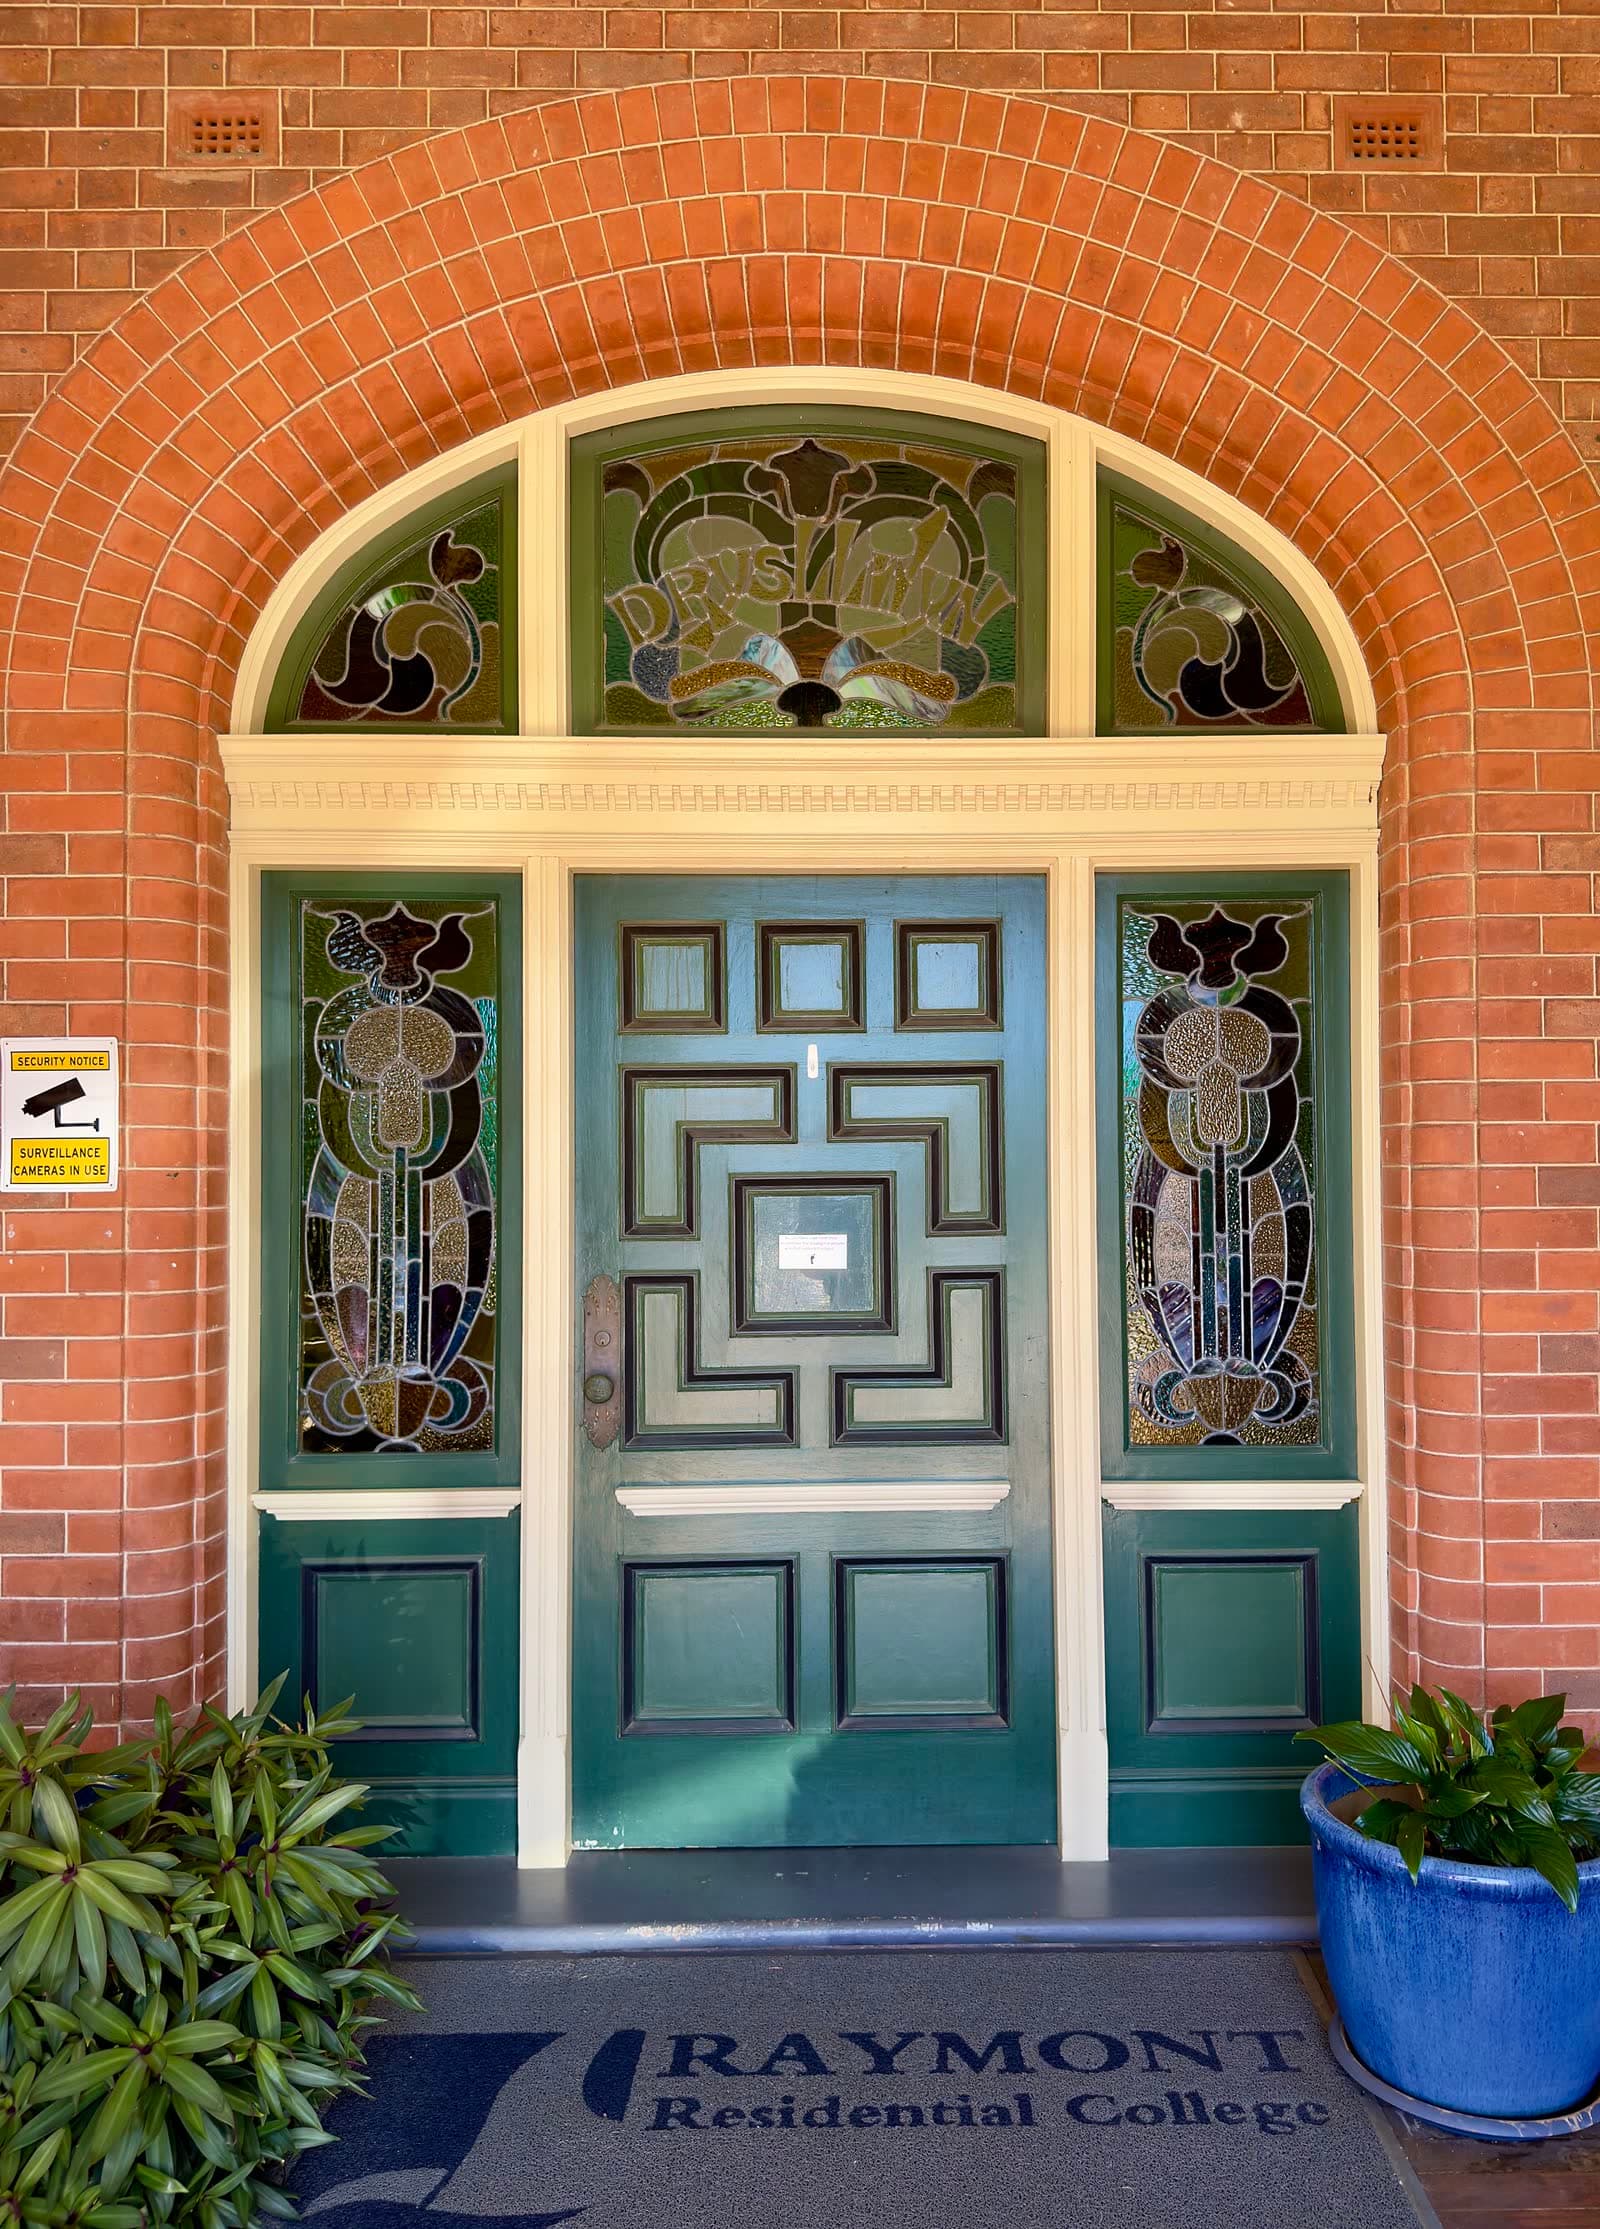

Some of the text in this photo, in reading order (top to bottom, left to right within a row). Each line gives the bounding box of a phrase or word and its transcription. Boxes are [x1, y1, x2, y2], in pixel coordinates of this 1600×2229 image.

[17, 1056, 105, 1067] SECURITY NOTICE
[20, 1147, 101, 1158] SURVEILLANCE
[13, 1165, 106, 1176] CAMERAS IN USE
[656, 2030, 1304, 2078] RAYMONT
[645, 2091, 1330, 2136] Residential College
